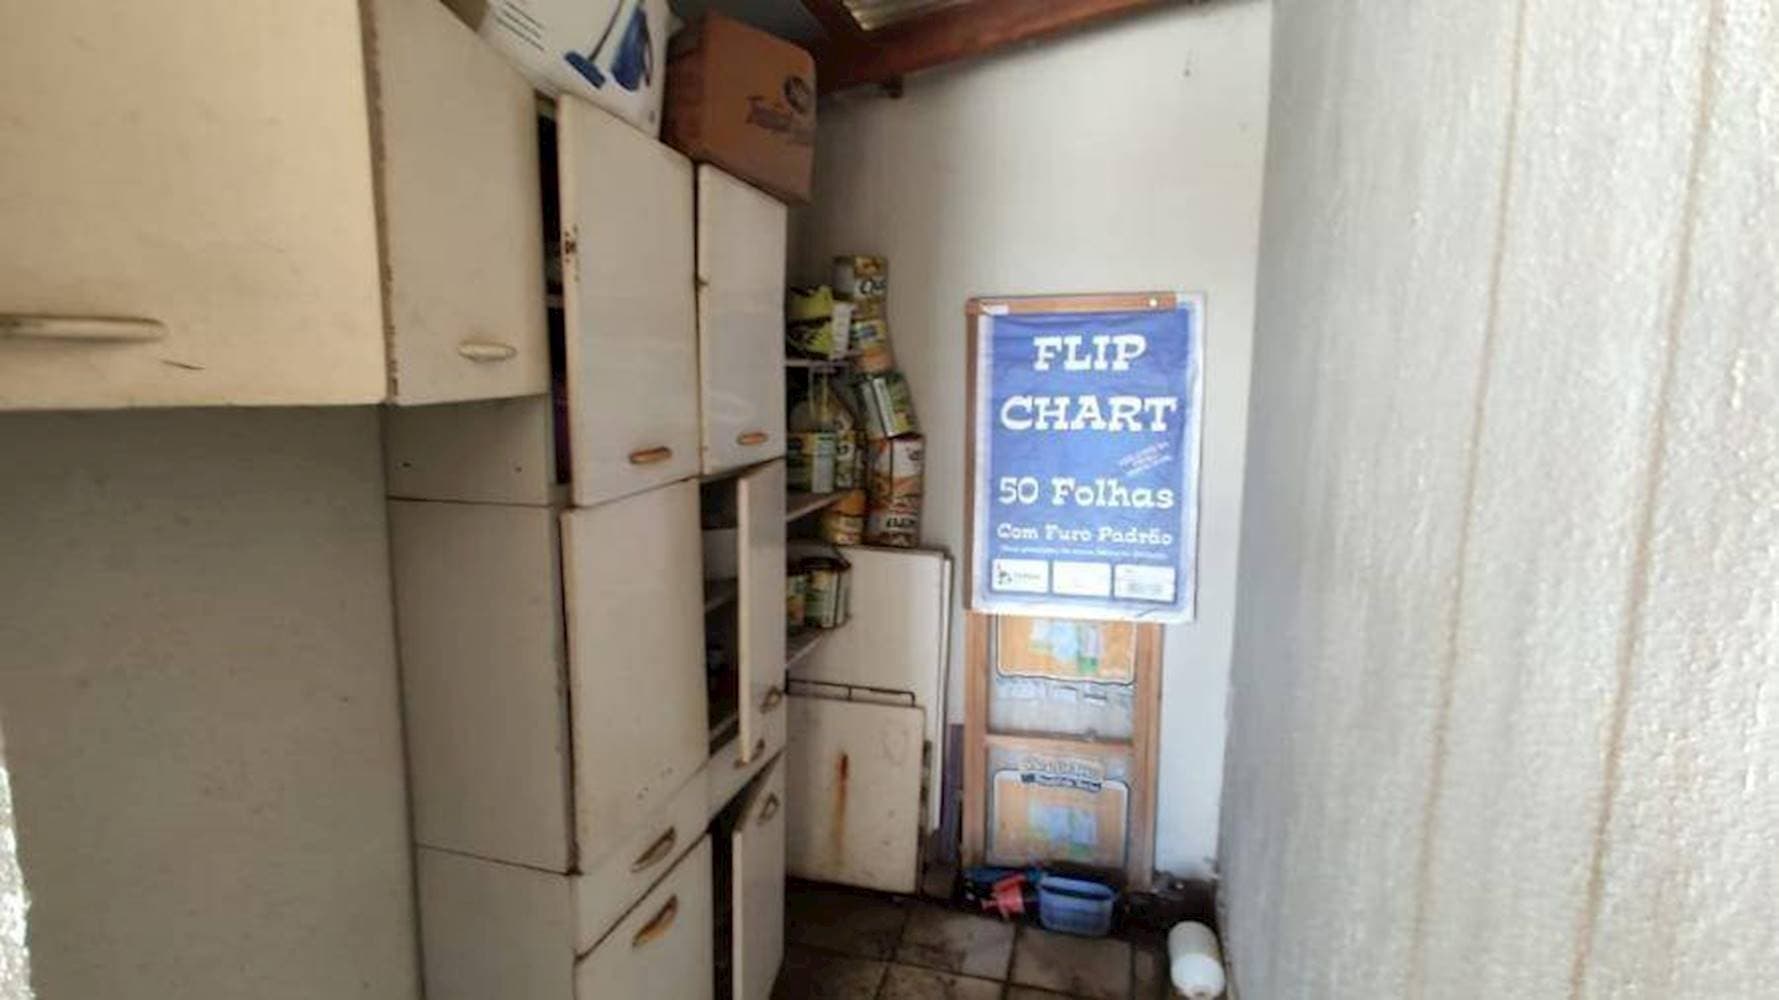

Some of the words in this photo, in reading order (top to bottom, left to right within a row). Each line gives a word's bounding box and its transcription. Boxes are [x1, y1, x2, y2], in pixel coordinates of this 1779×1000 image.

[1033, 334, 1146, 371] FLIP
[1001, 394, 1177, 431] CHART
[999, 476, 1039, 504] 50
[1051, 476, 1174, 509] Folhas
[997, 522, 1039, 540] Com
[1045, 523, 1092, 542] Furo
[1098, 525, 1173, 545] Padrão
